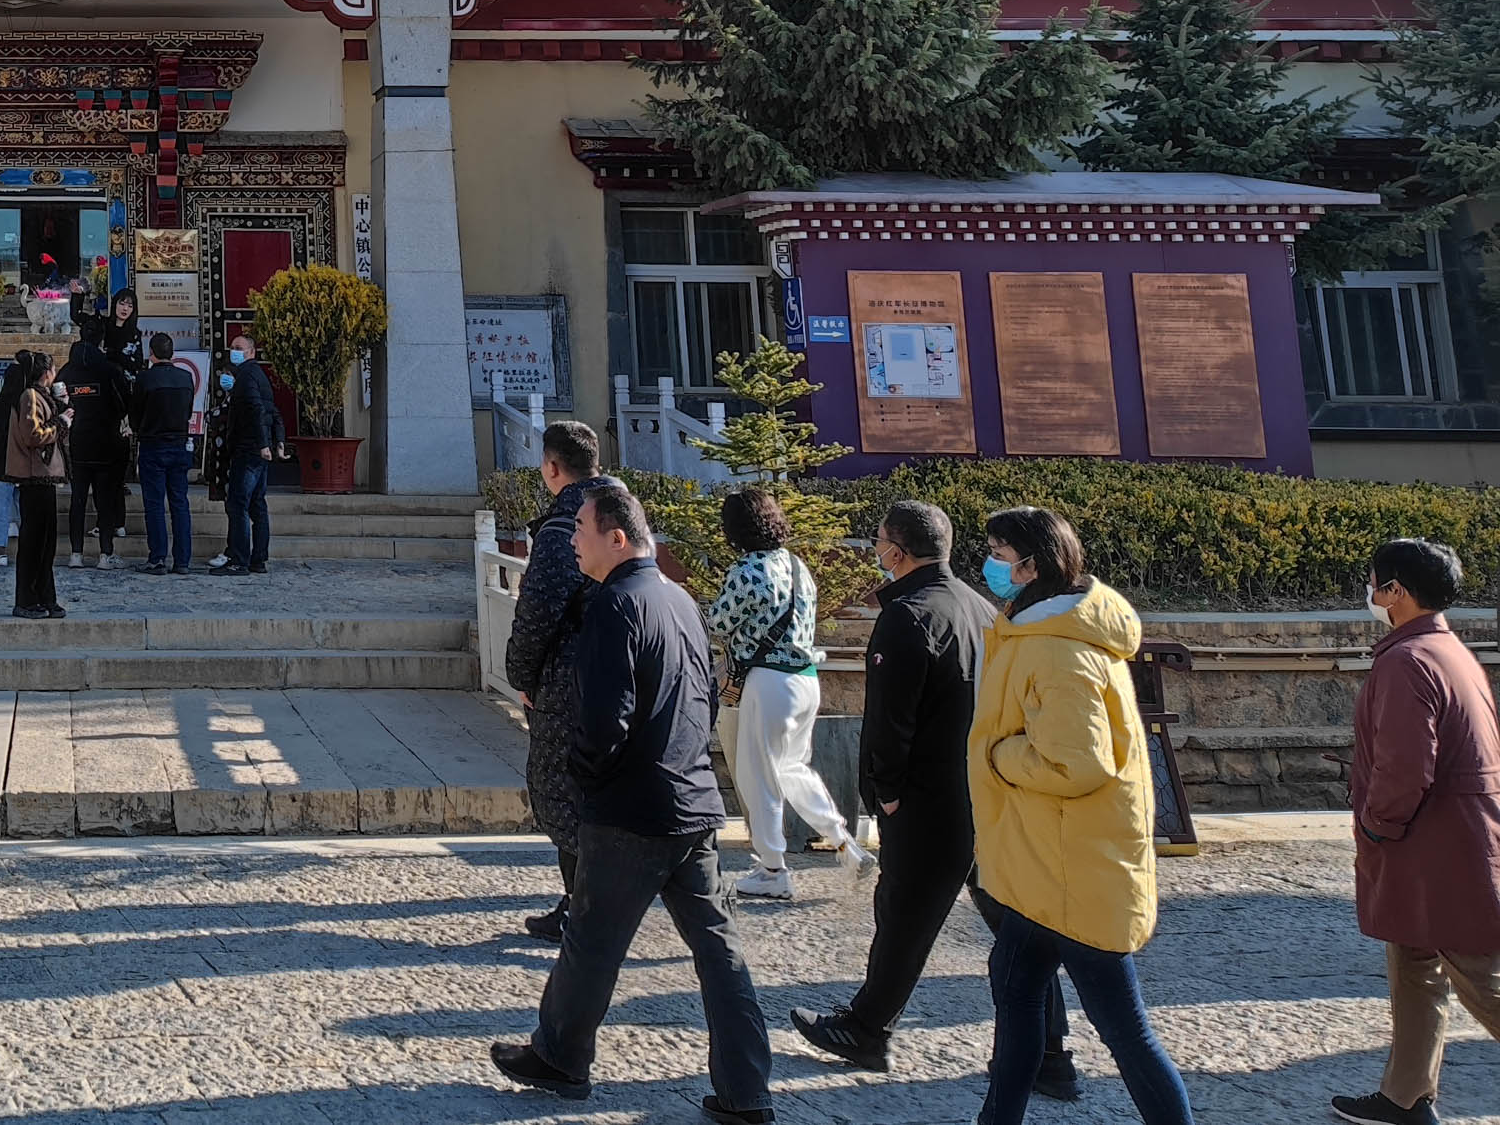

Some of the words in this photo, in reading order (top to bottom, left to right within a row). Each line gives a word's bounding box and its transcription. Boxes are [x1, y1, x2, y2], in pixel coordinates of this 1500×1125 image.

[868, 299, 946, 308] 迪庆红军长征博物馆
[812, 319, 845, 329] 温馨提示
